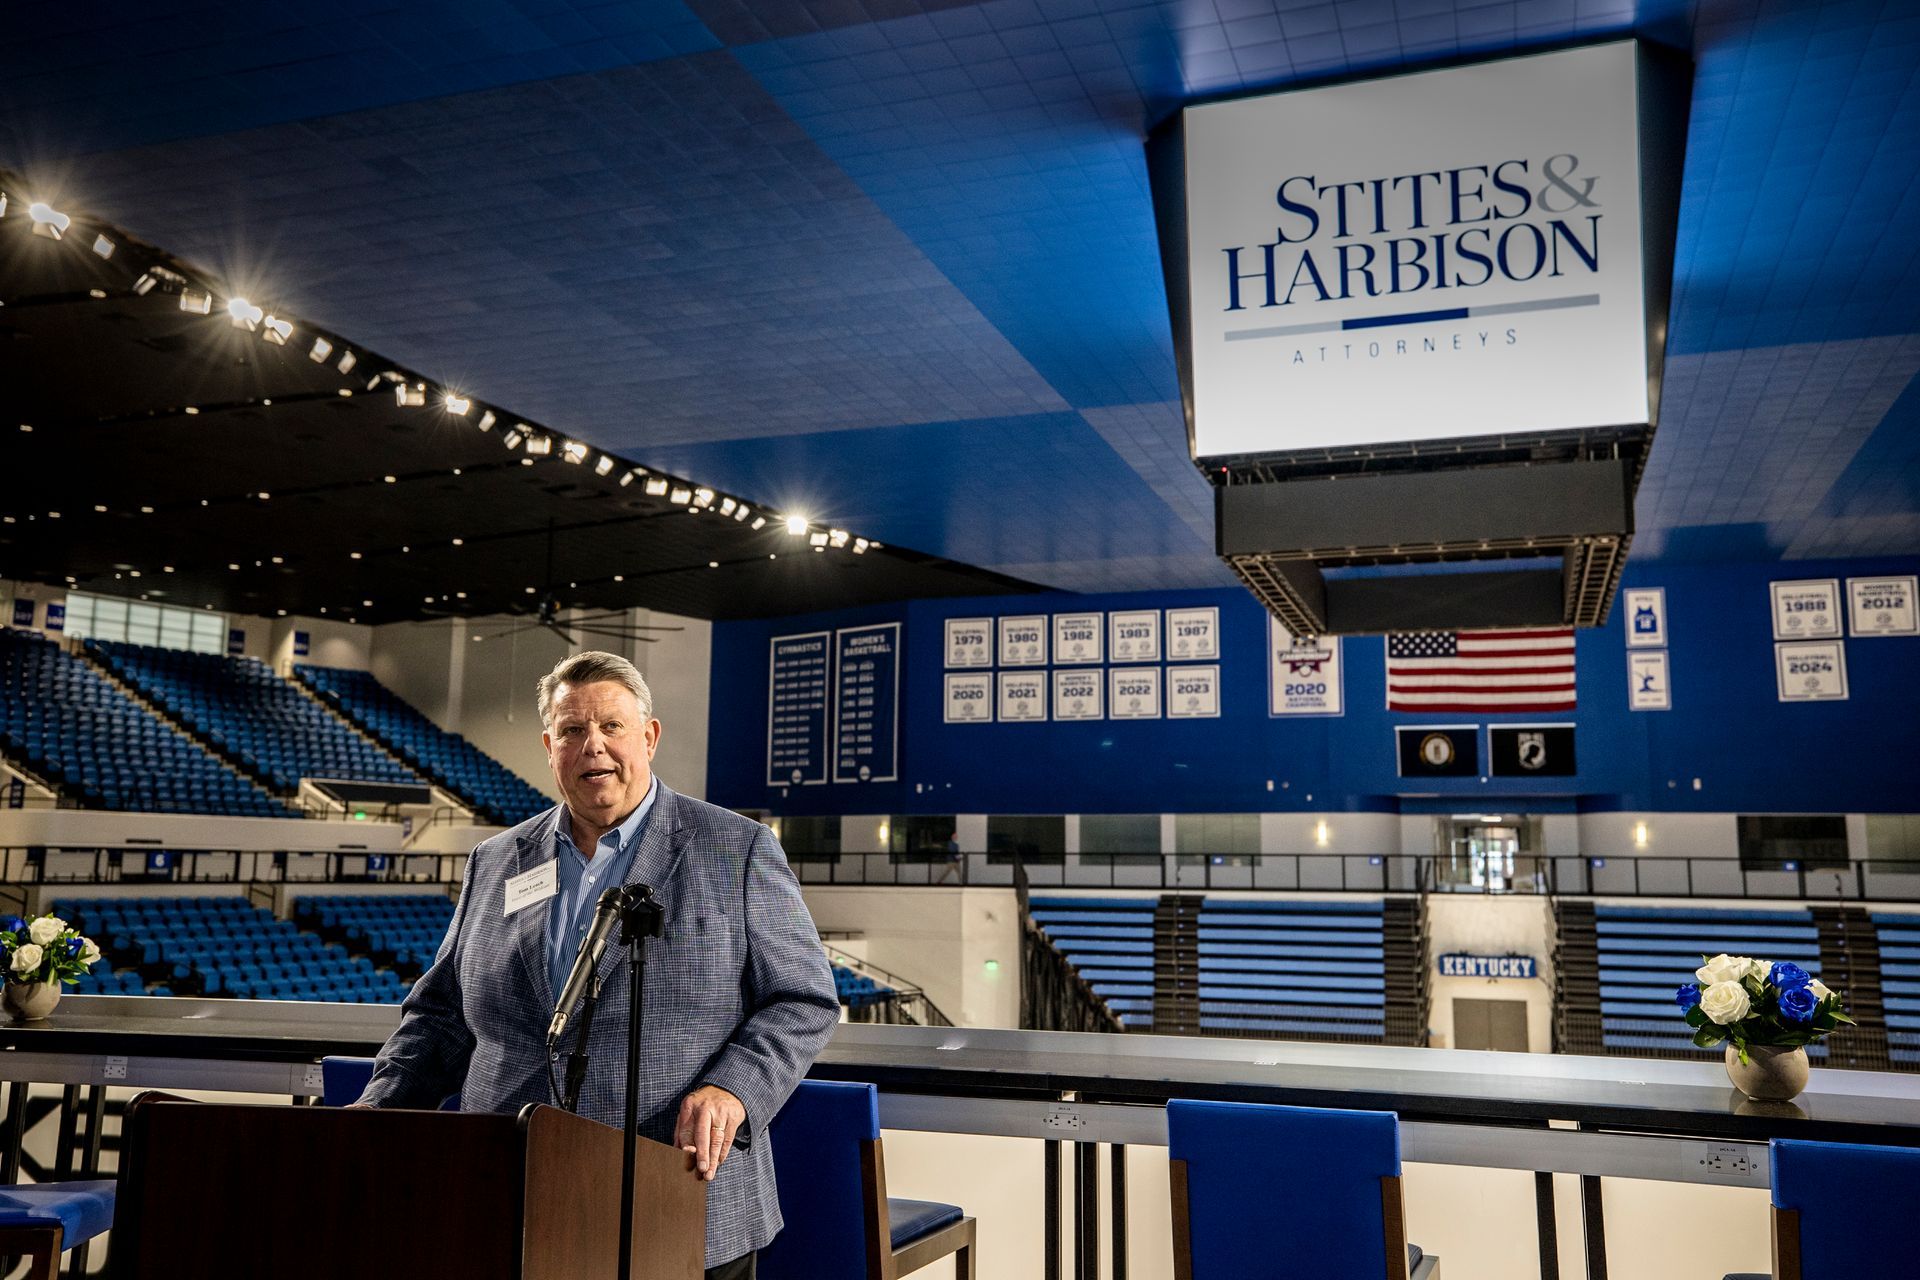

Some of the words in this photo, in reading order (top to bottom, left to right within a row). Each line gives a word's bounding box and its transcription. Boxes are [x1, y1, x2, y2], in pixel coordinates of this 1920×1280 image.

[1221, 214, 1604, 312] HARBISON
[1292, 328, 1518, 364] ATTORNEYS
[1785, 600, 1827, 613] 1988
[1862, 597, 1905, 610] 2012
[1063, 630, 1094, 641] 1982
[1119, 628, 1150, 639] 1983
[1177, 626, 1209, 637] 1987
[954, 635, 984, 645] 1979
[1008, 632, 1039, 643] 1980
[1789, 661, 1833, 674] 2024
[1008, 688, 1038, 699] 2021
[1062, 686, 1094, 698] 2022
[1119, 685, 1151, 696] 2022
[1177, 684, 1210, 695] 2023
[1285, 683, 1327, 695] 2020
[953, 690, 984, 700] 2020
[155, 854, 165, 868] 6
[1443, 956, 1532, 977] KENTUCKY
